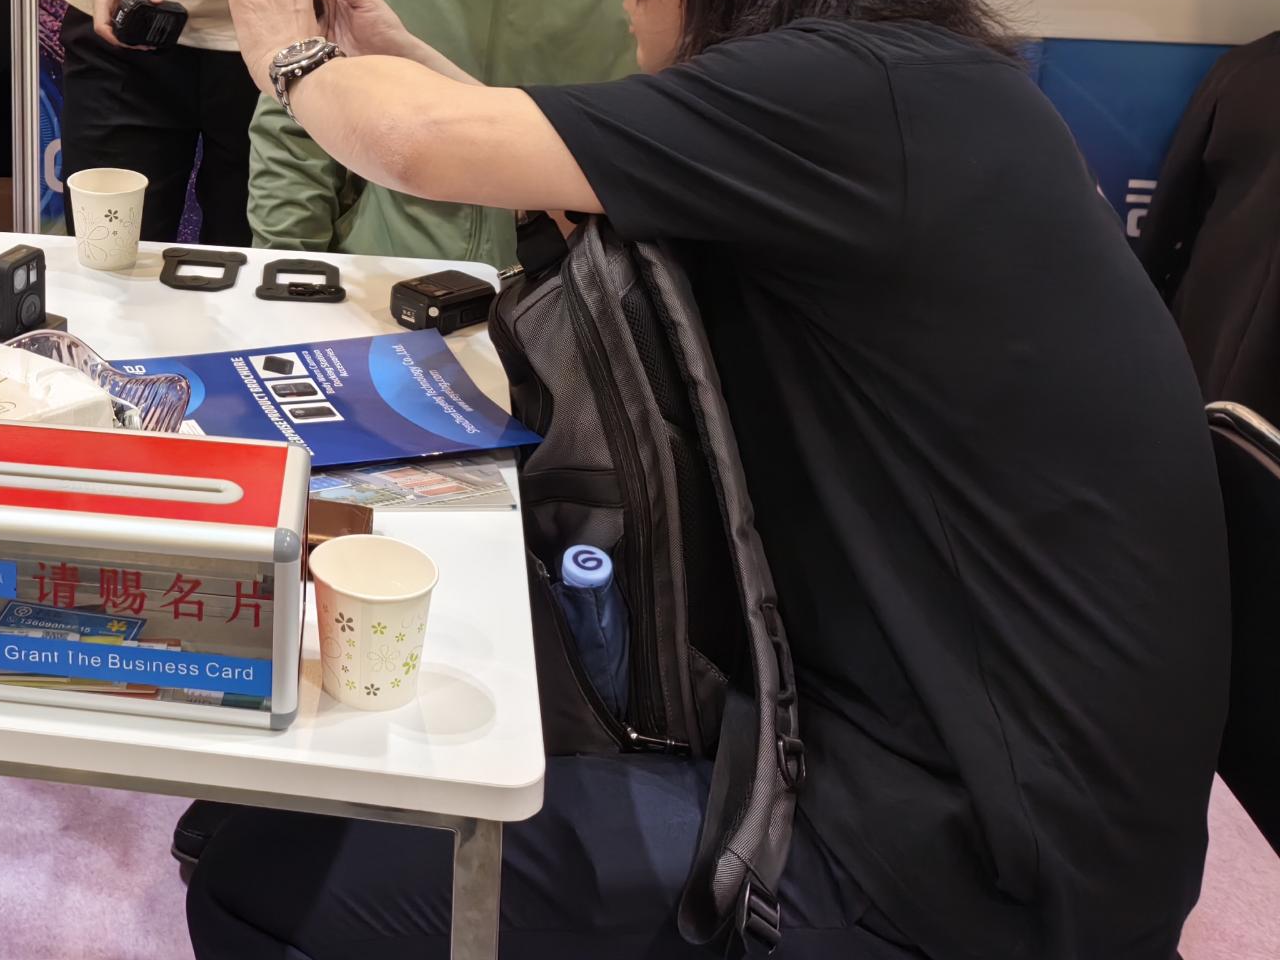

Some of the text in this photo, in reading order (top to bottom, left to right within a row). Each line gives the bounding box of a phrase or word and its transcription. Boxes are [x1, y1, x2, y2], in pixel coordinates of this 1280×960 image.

[230, 356, 264, 393] BROCHURE
[32, 561, 274, 628] 请赐名片
[4, 644, 60, 664] Grant
[67, 649, 102, 668] The
[108, 652, 199, 677] Business
[205, 662, 254, 682] Card
